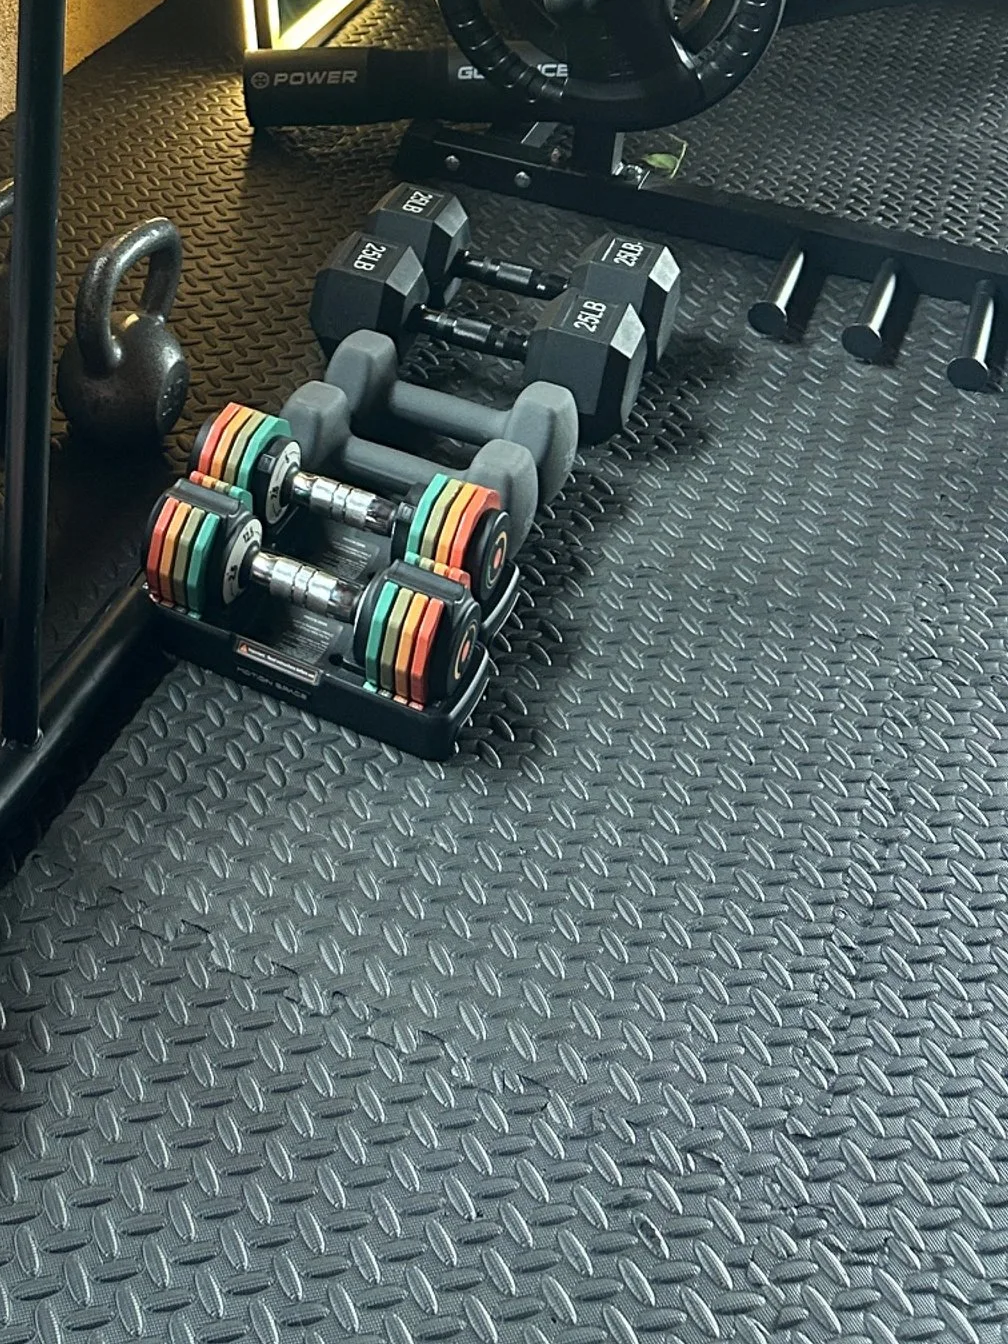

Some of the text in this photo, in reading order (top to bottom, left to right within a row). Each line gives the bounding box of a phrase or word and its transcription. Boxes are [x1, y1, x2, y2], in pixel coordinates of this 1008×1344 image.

[273, 70, 358, 86] POWER
[402, 190, 433, 213] 25LB
[353, 242, 387, 271] 25LB
[613, 242, 644, 267] 25LB
[573, 301, 607, 332] 25LB
